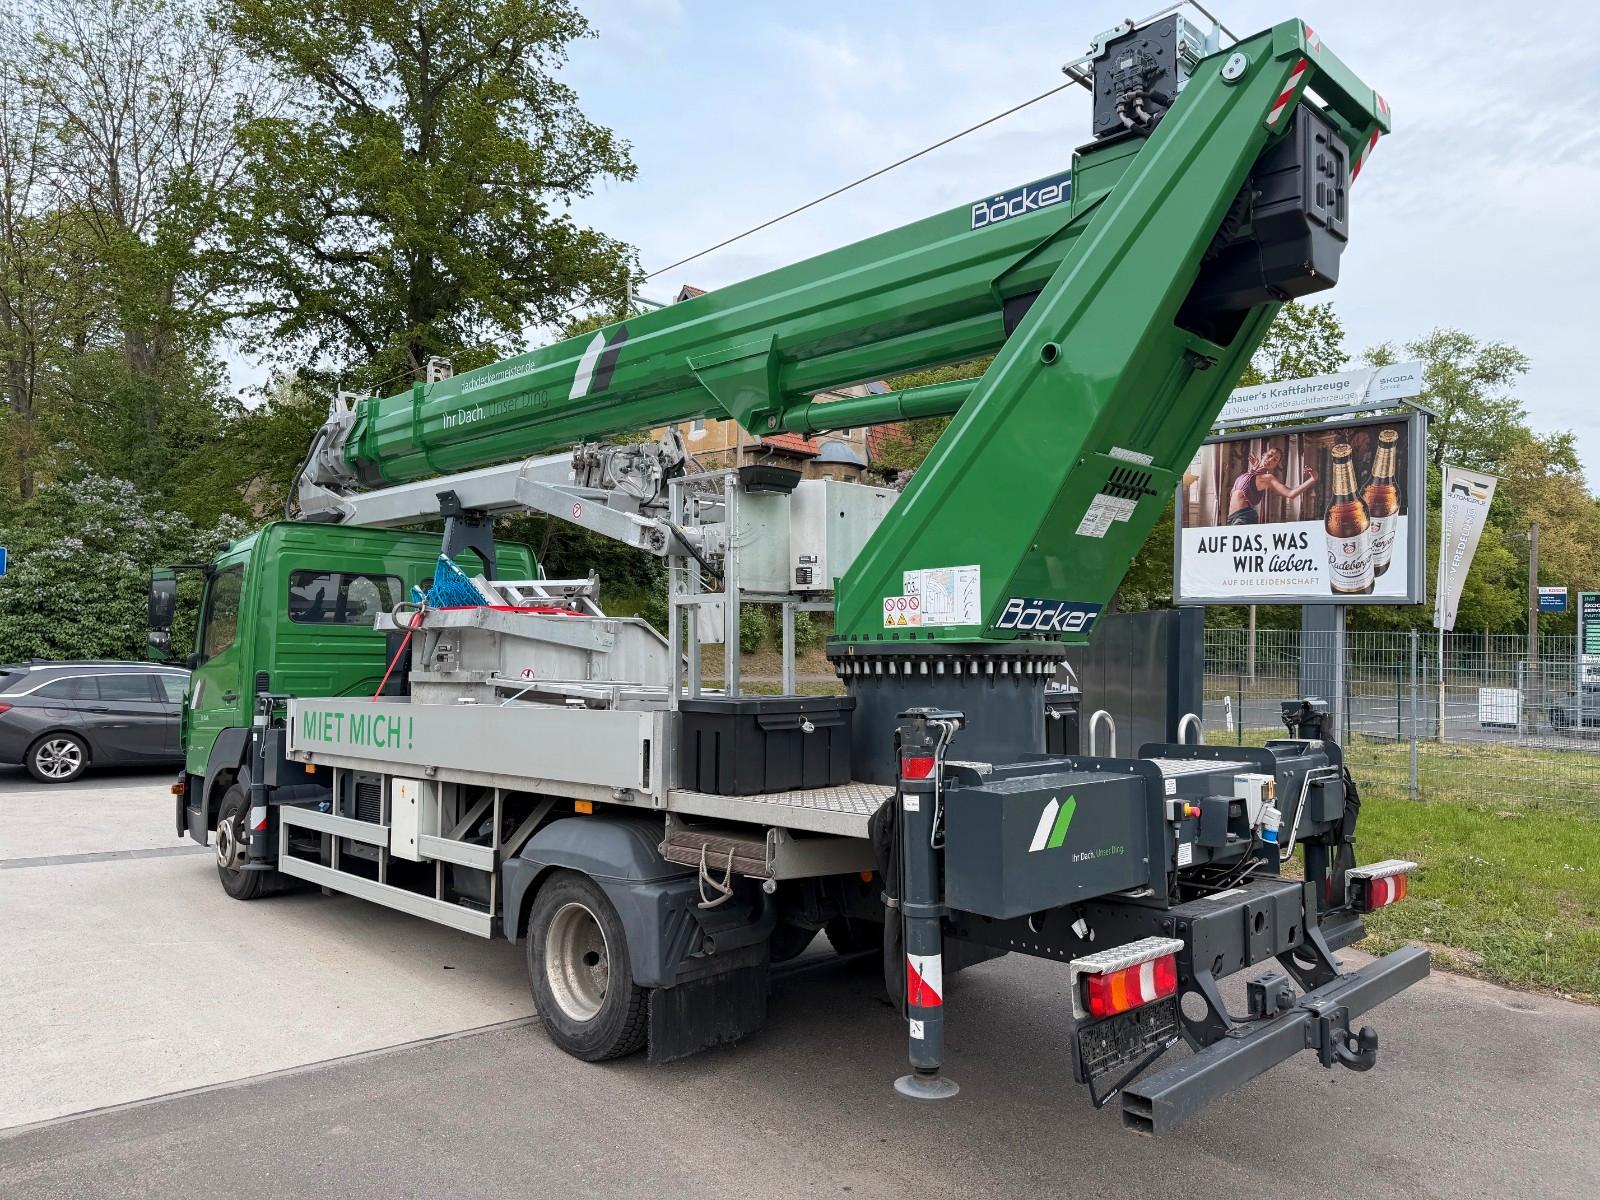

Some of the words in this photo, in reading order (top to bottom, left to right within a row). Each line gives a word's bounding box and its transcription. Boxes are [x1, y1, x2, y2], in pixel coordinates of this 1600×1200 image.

[972, 179, 1071, 229] Böcker
[1270, 381, 1350, 398] Kraftfahrzeuge
[443, 411, 457, 429] Ihr
[458, 403, 486, 425] Dach.
[1253, 404, 1269, 412] und
[1198, 536, 1228, 553] AUF
[1232, 534, 1268, 555] DAS,
[1272, 532, 1309, 550] WAS
[1450, 508, 1476, 575] VEREDELUNG
[1233, 555, 1264, 573] WIR
[1268, 553, 1318, 572] lieben.
[1256, 577, 1319, 586] LEIDENSCHAFT
[995, 598, 1098, 632] Böcker
[303, 710, 345, 743] MIET
[349, 713, 401, 749] MICH
